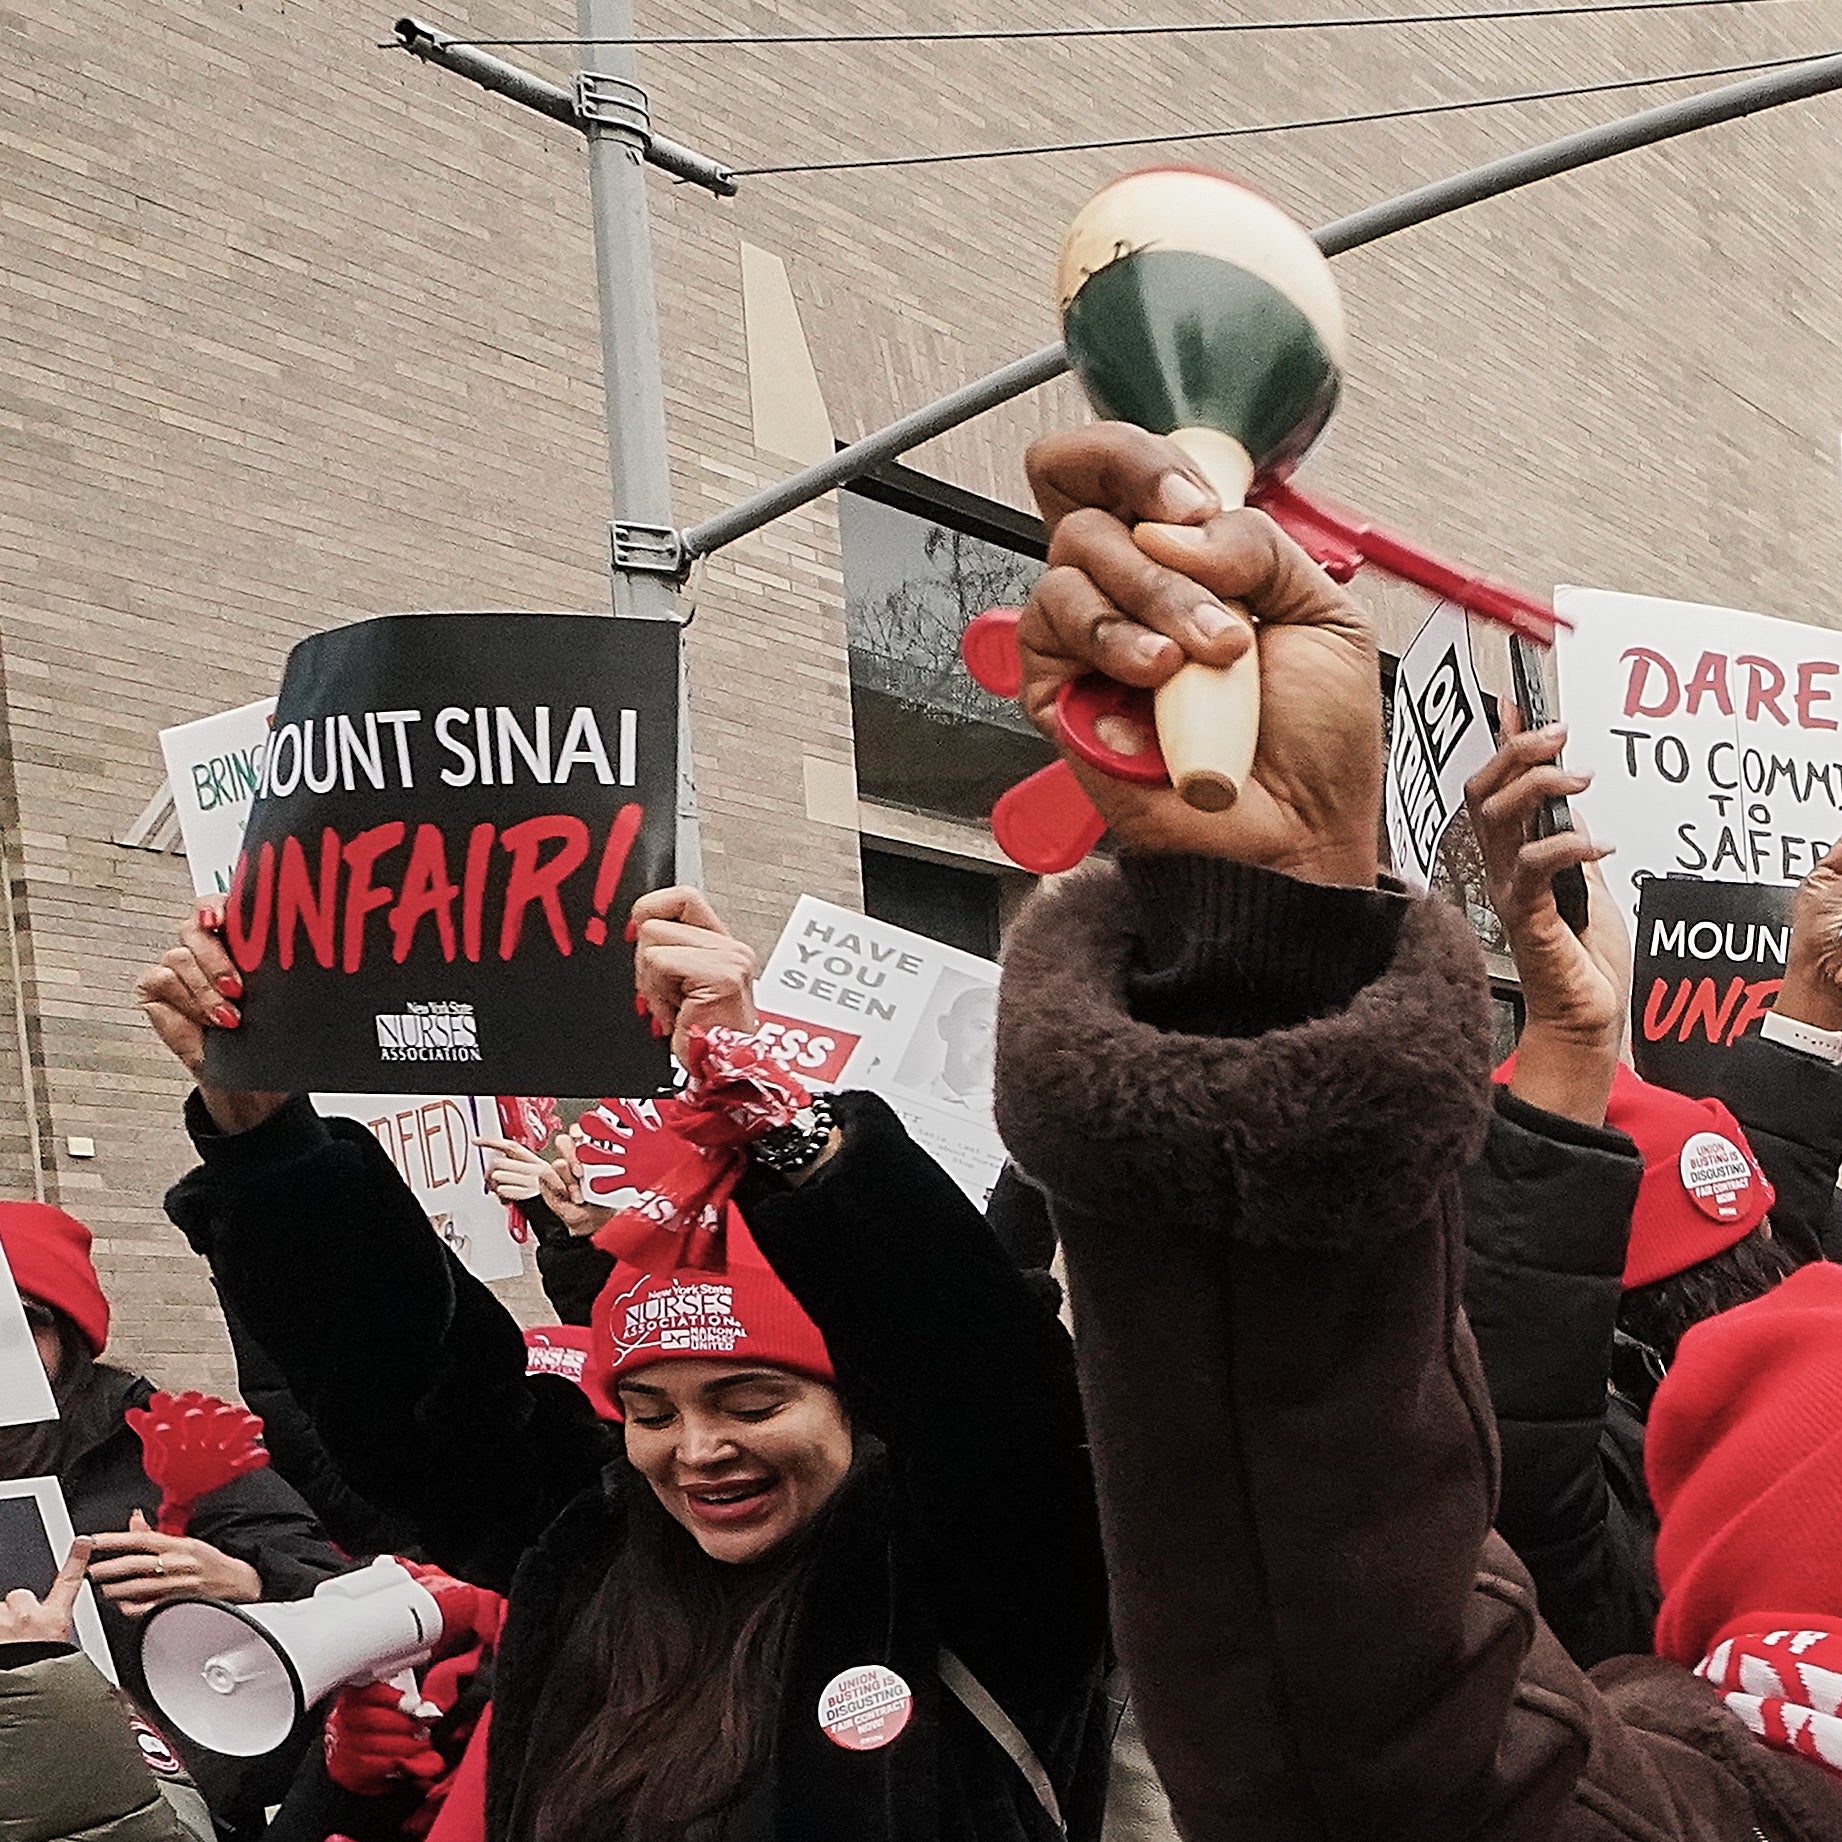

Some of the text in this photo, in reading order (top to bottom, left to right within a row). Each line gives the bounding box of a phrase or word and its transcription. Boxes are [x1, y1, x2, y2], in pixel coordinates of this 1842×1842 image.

[1619, 647, 1841, 730] DARE
[1423, 664, 1467, 763] ON
[259, 707, 638, 799] OUNT SINAI
[1609, 730, 1688, 783] TO
[1715, 795, 1772, 824] TO
[226, 803, 644, 973] UNFAIR!
[803, 920, 923, 976] HAVE
[1650, 919, 1794, 964] MOUN
[797, 943, 886, 988] YOU
[407, 1001, 473, 1015] New York State
[780, 970, 896, 1020] SEEN
[376, 1014, 478, 1047] NURSES
[381, 1047, 483, 1062] ASSOCIATION
[1690, 1151, 1738, 1169] BUSTING IS
[1690, 1162, 1745, 1183] DISGUSTING
[648, 1278, 733, 1300] New York State
[625, 1294, 733, 1328] NURSES
[691, 1327, 747, 1338] NATIONAL
[691, 1341, 734, 1351] UNITED
[828, 1675, 895, 1707] BUSTING IS
[838, 1671, 877, 1692] UNION
[826, 1685, 904, 1721] DISGUSTING
[854, 1700, 907, 1724] CONTRACT
